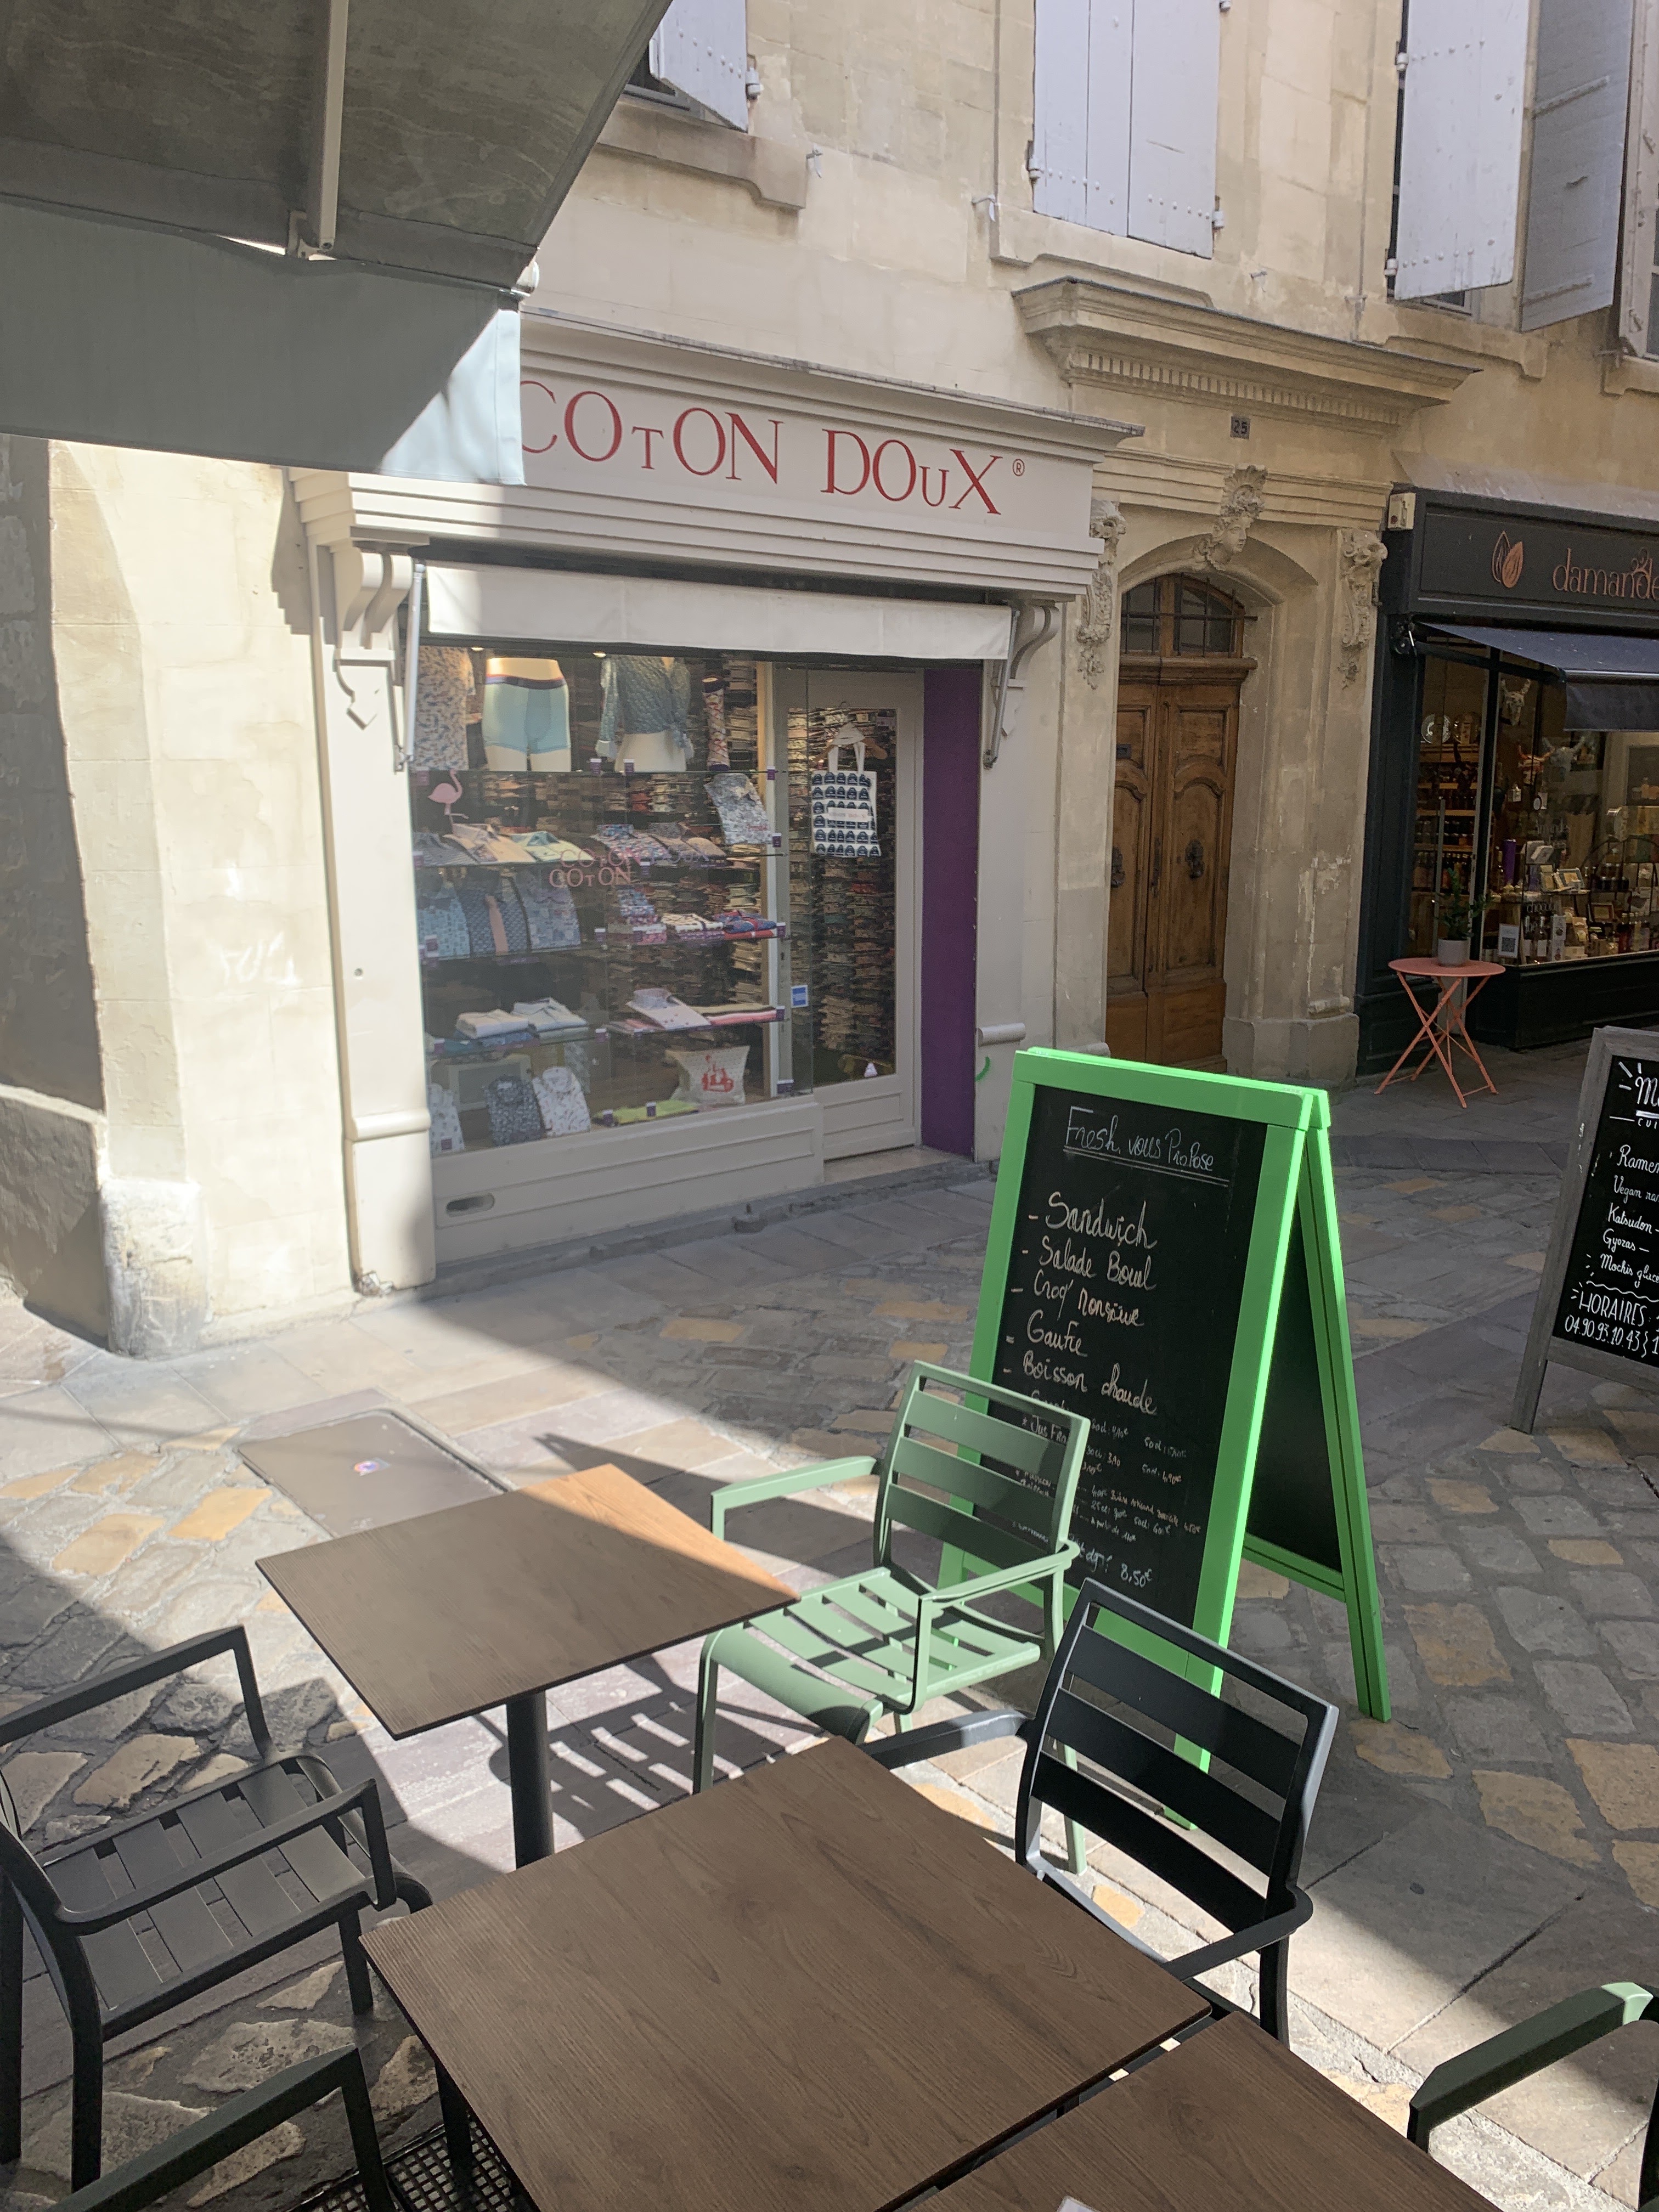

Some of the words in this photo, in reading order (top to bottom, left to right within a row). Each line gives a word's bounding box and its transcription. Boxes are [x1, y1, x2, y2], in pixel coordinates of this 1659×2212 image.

[1234, 419, 1248, 434] 25
[549, 866, 631, 888] COTON
[1613, 1174, 1642, 1204] Vegan
[1045, 1191, 1158, 1249] Sandwich
[1607, 1202, 1652, 1234] Katsudon
[1602, 1228, 1636, 1253] Gyozas
[1039, 1235, 1097, 1278] Salade
[1600, 1253, 1633, 1276] Mochis
[1578, 1290, 1647, 1327] HORAIRES
[1023, 1350, 1088, 1393] Boisson
